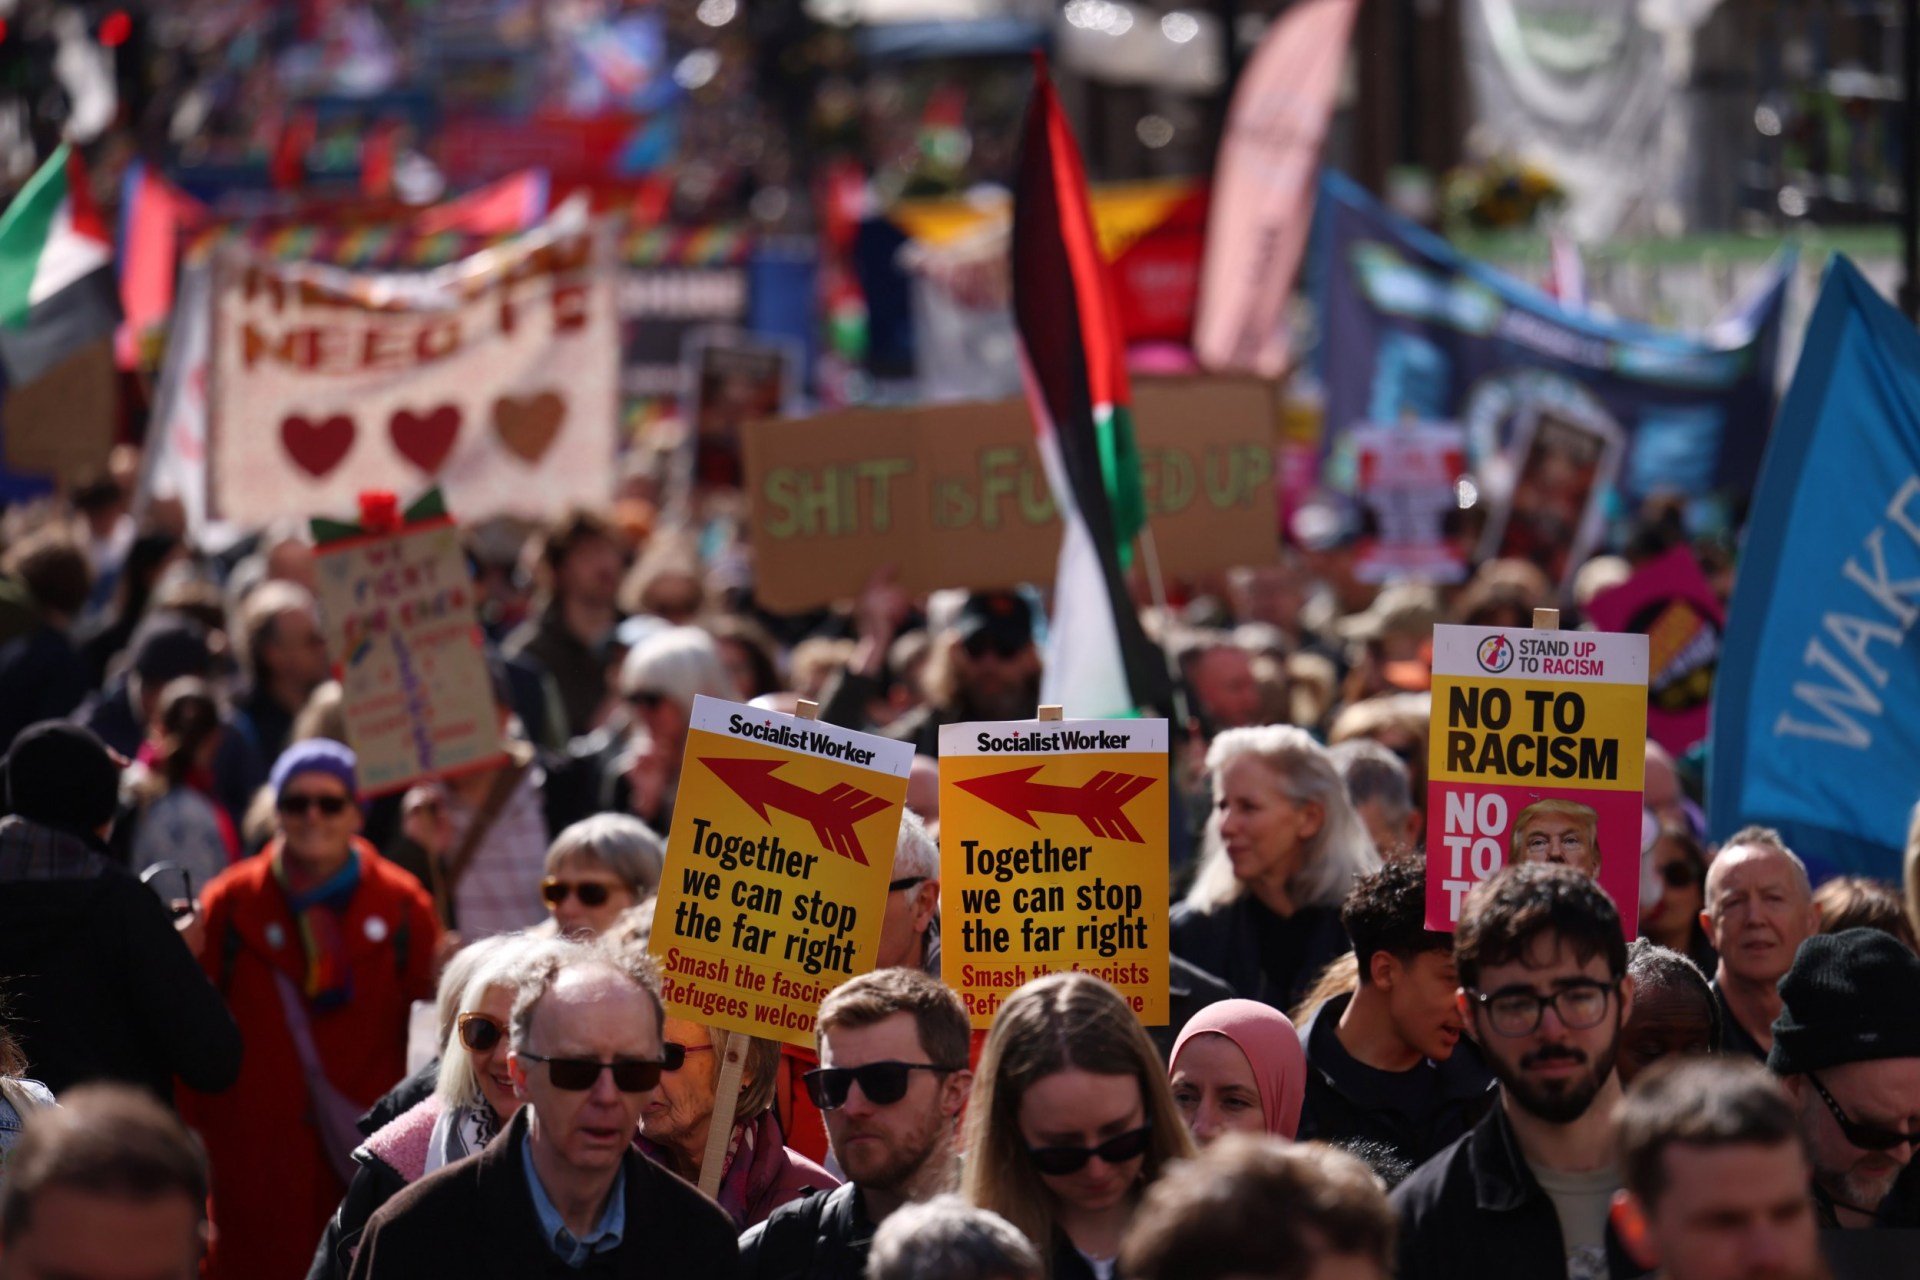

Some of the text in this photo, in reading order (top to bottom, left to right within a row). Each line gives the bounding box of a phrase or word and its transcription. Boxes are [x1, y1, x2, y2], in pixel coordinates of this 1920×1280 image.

[762, 456, 913, 538] SHIT
[979, 446, 1196, 529] FUED
[1205, 444, 1273, 511] UP
[1519, 639, 1596, 658] STAND UP
[1519, 657, 1604, 676] TO RACISM
[1448, 686, 1585, 734] NO TO
[729, 713, 875, 765] Socialist Worker
[977, 730, 1130, 752] Socialist Worker
[1447, 731, 1619, 781] RACISM
[1445, 791, 1508, 837] NO
[693, 817, 818, 880] Together
[961, 838, 1092, 882] Together
[1443, 836, 1502, 881] TO
[683, 867, 857, 939] we can stop
[962, 877, 1142, 918] we can stop
[674, 901, 856, 975] the far right
[962, 915, 1148, 958] the far right
[666, 947, 837, 1005] Smash the fascis
[962, 964, 1026, 987] Smash
[1072, 961, 1149, 985] scists
[661, 976, 817, 1033] Refugees welco
